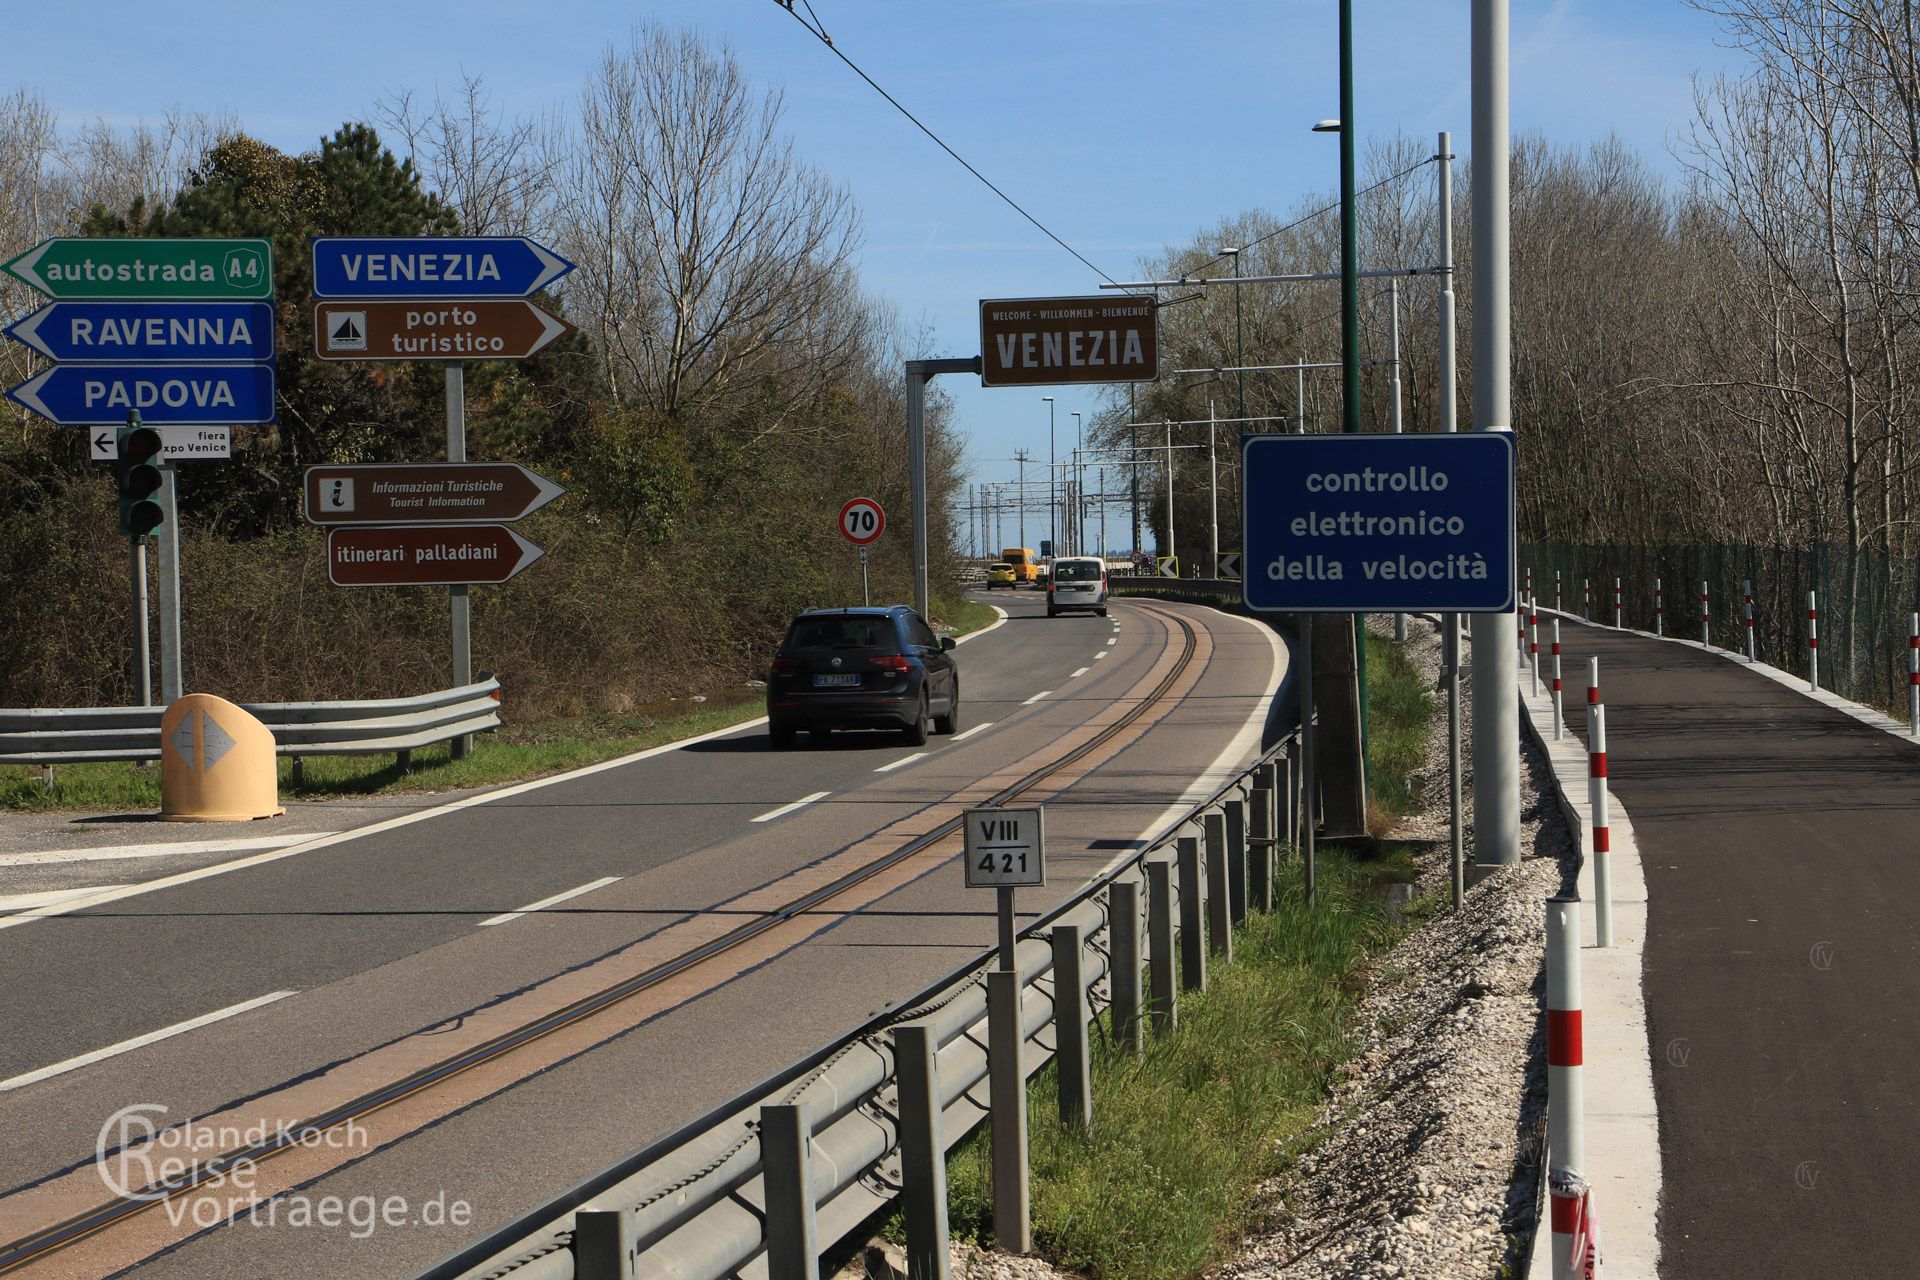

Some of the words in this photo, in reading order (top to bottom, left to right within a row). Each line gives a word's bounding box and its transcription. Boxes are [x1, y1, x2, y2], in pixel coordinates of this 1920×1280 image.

[47, 259, 215, 281] autostrada
[230, 258, 257, 278] A4
[342, 255, 500, 280] VENEZIA
[407, 307, 476, 329] porto
[993, 311, 1030, 320] WELCOME
[1040, 309, 1093, 319] WILLKOMMEN
[1102, 307, 1149, 317] BIENVENUE
[72, 319, 252, 345] RAVENNA
[392, 332, 503, 352] turistico
[997, 329, 1143, 368] VENEZIA
[85, 380, 235, 407] PADOVA
[199, 432, 225, 440] fiera
[188, 443, 226, 451] Venice
[373, 481, 444, 493] Informazioni
[448, 480, 503, 491] Turistiche
[1307, 466, 1448, 492] controllo
[390, 497, 423, 507] Tourist
[429, 496, 485, 506] Information
[849, 510, 874, 532] 70
[1291, 510, 1464, 536] elettronico
[338, 545, 403, 562] itinerari
[416, 544, 497, 563] palladiani
[1268, 555, 1343, 580] della
[1362, 553, 1487, 579] velocità
[981, 821, 1018, 841] VIII
[978, 853, 1026, 873] 421
